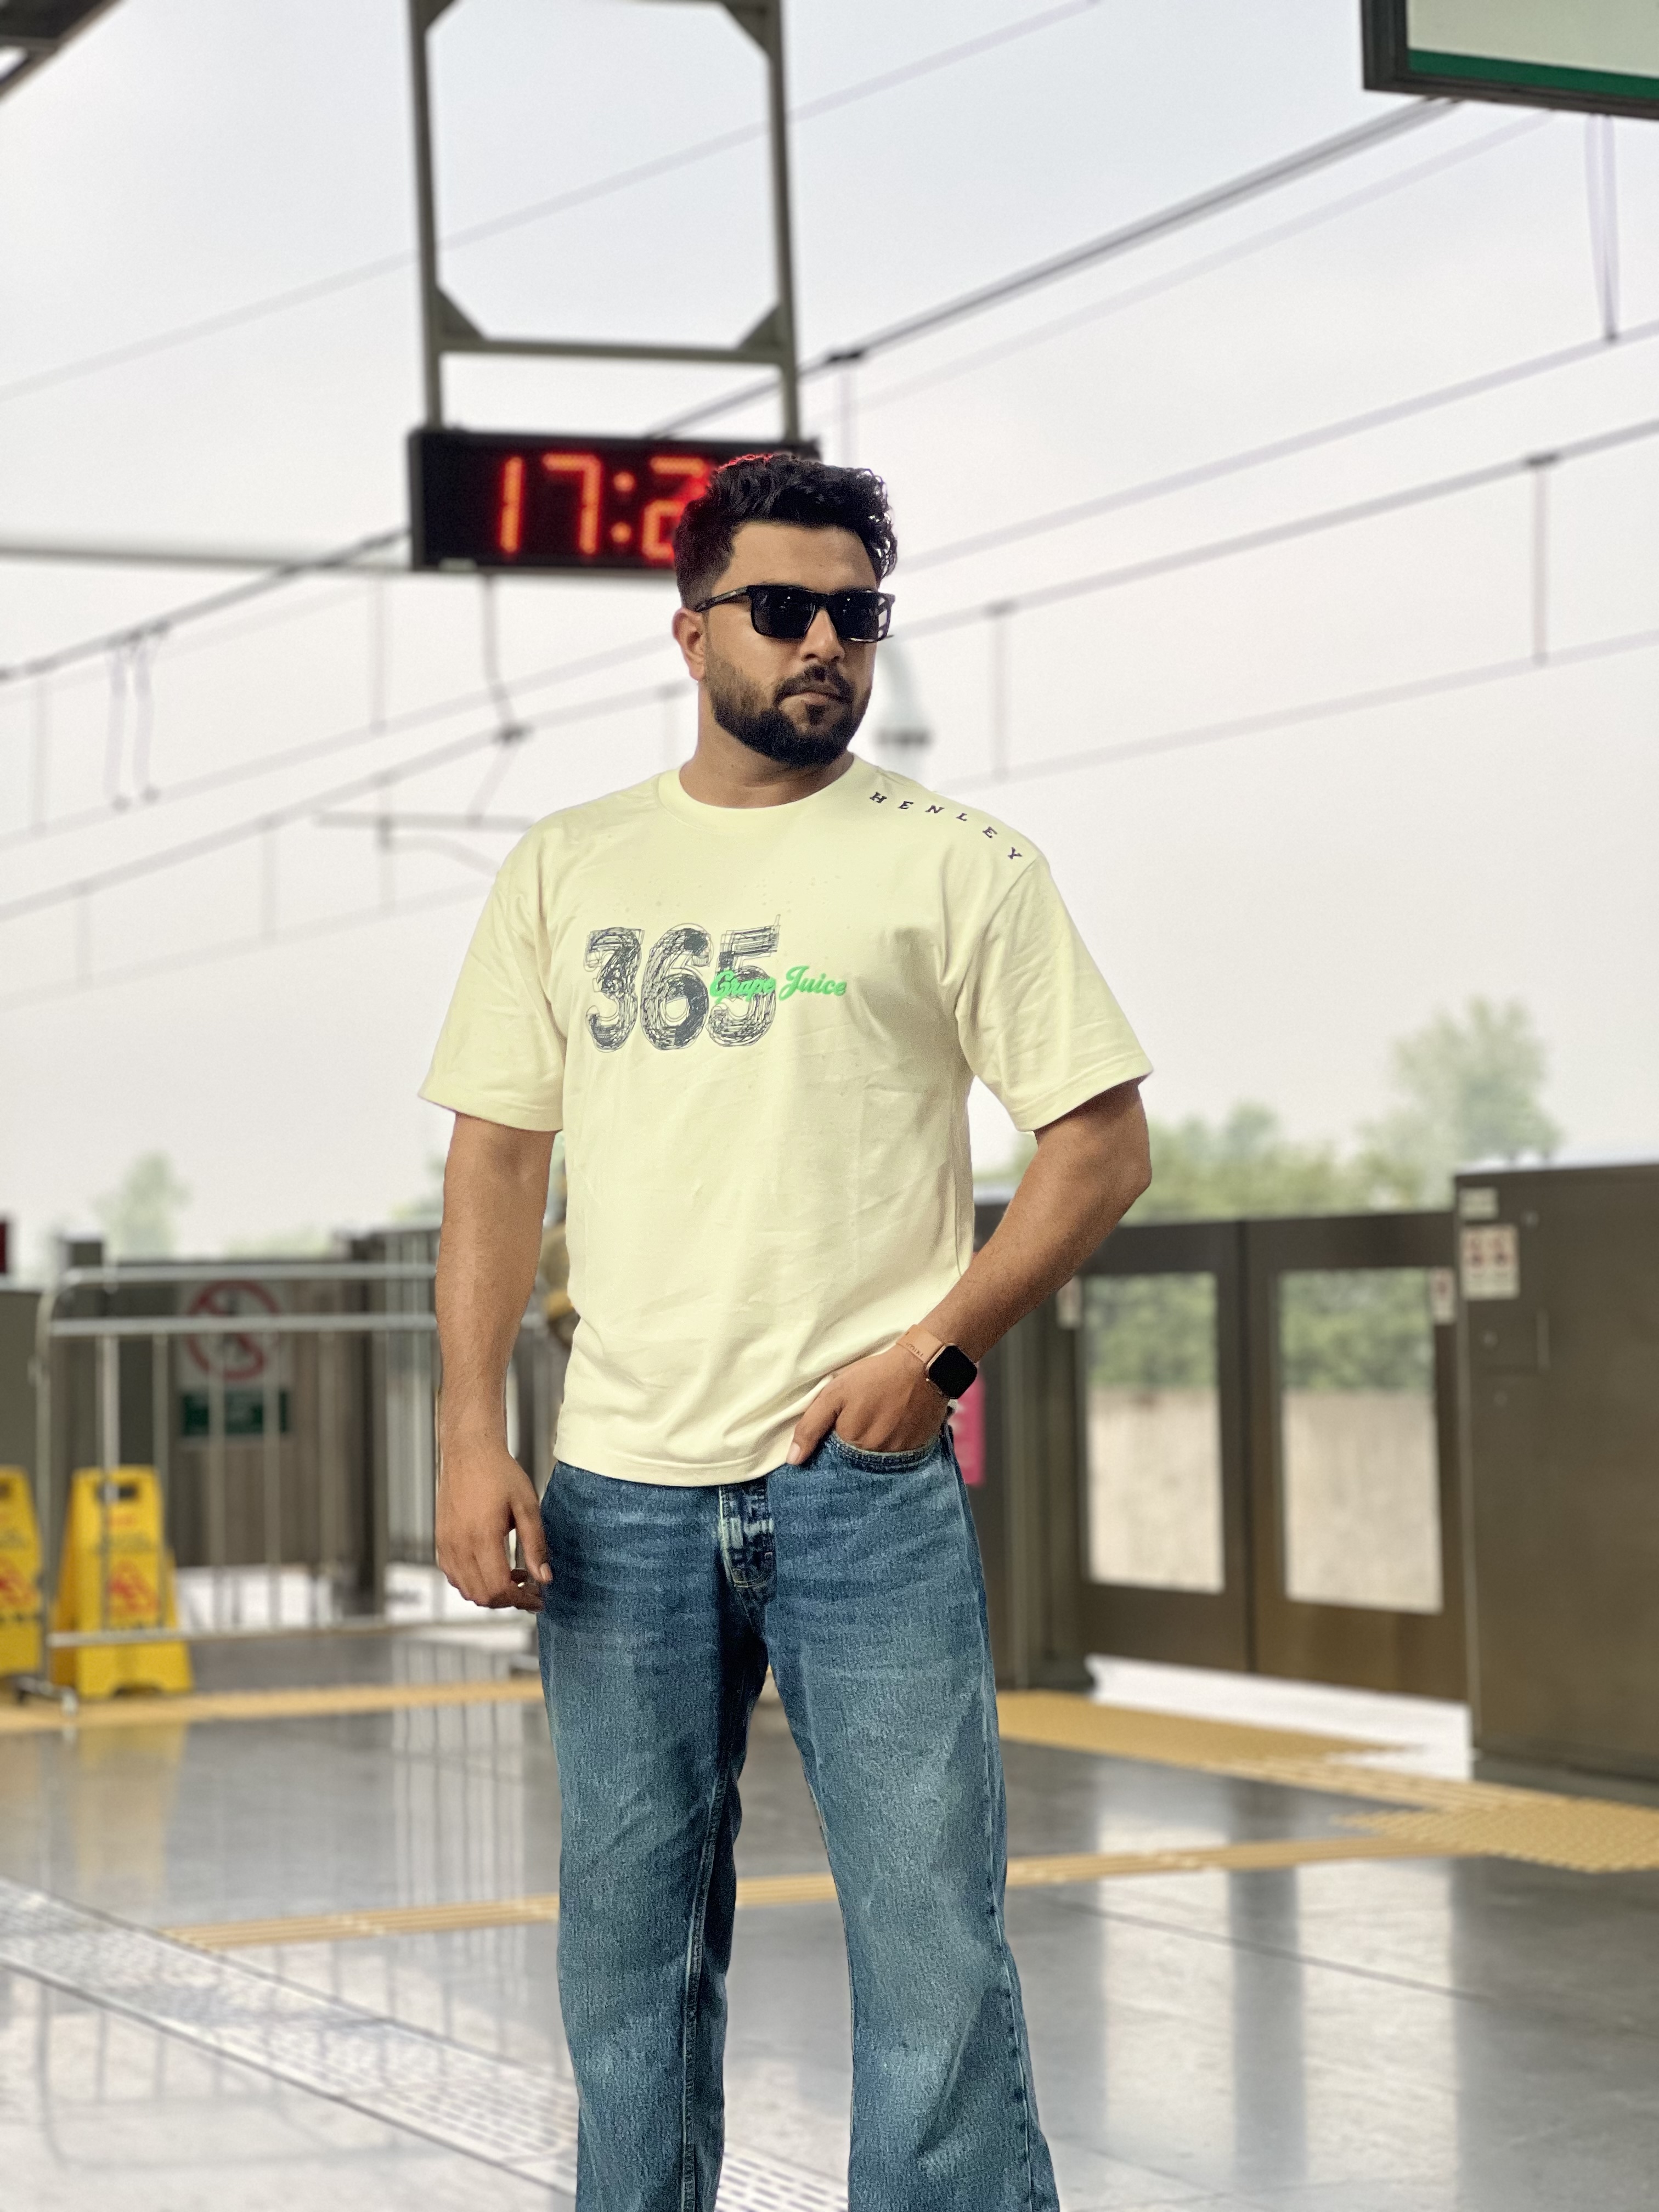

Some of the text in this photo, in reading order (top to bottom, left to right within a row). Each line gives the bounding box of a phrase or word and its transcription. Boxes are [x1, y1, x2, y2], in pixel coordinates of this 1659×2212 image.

[499, 453, 712, 560] 17:2
[869, 791, 1023, 860] HENLEY
[584, 915, 781, 1053] 365
[709, 965, 848, 1005] Grape Juice
